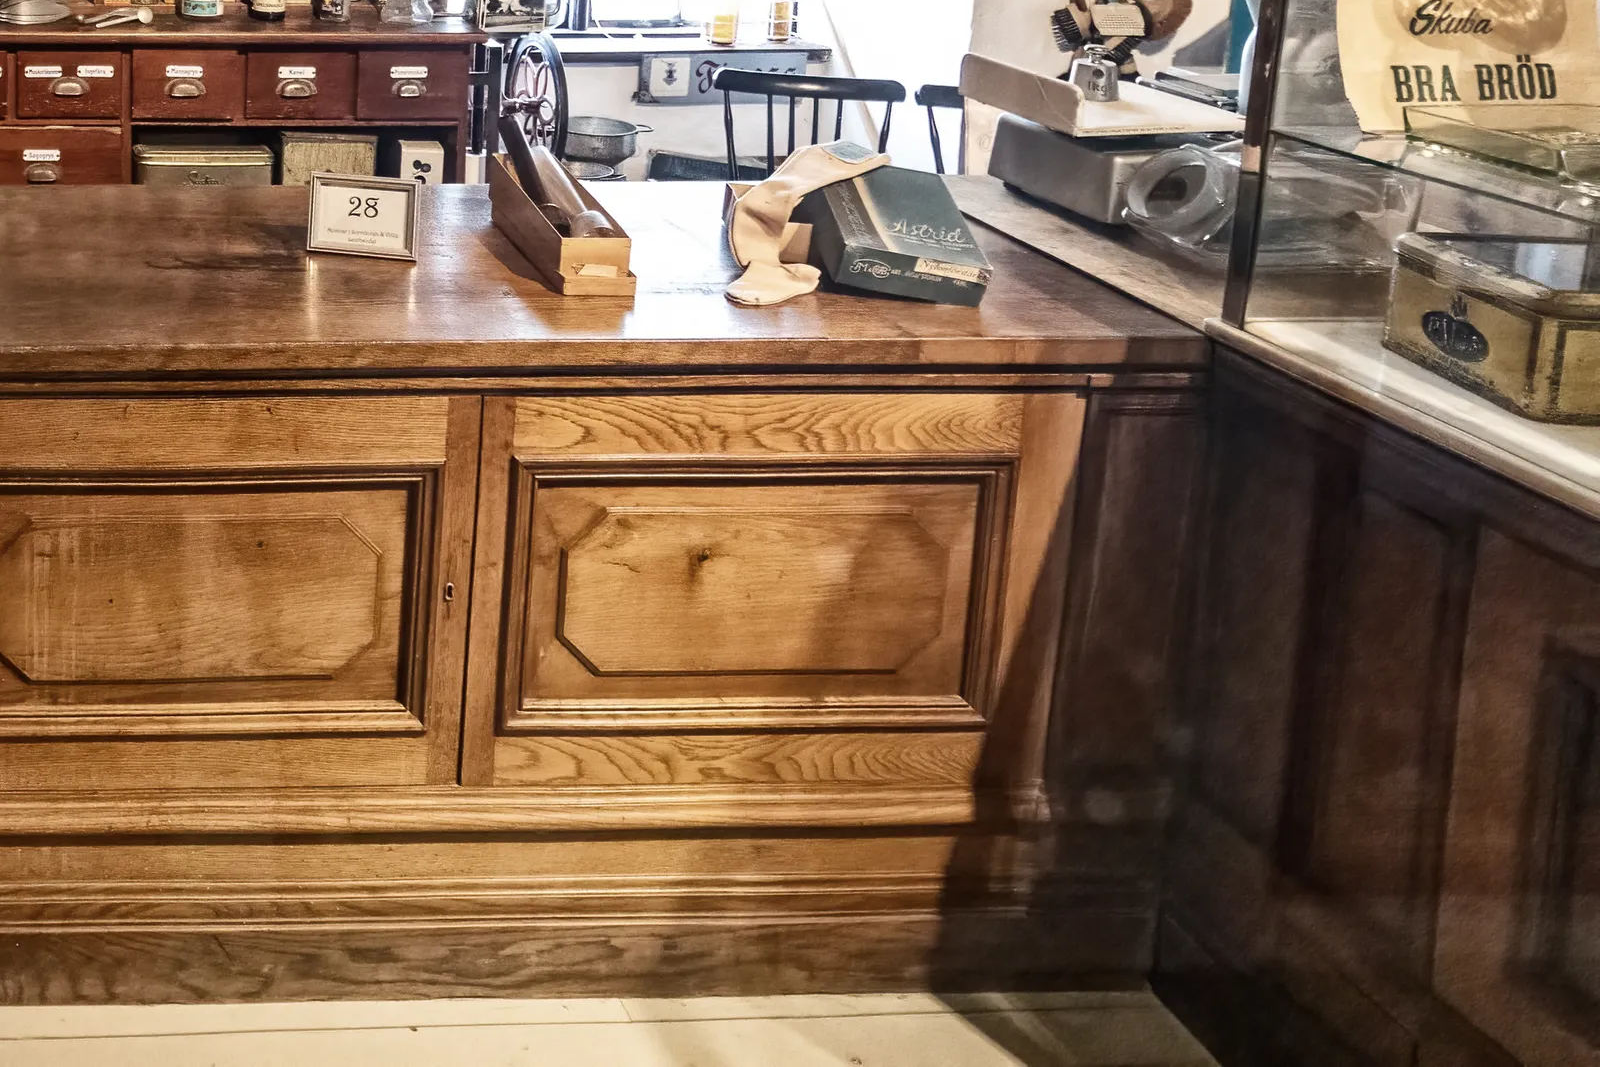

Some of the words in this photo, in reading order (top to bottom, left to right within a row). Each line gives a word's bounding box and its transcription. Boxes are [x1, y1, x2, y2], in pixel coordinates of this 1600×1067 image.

[1390, 65, 1462, 103] BRA
[1474, 54, 1557, 101] BRÖD
[347, 195, 380, 218] 28
[887, 219, 966, 243] Astrid
